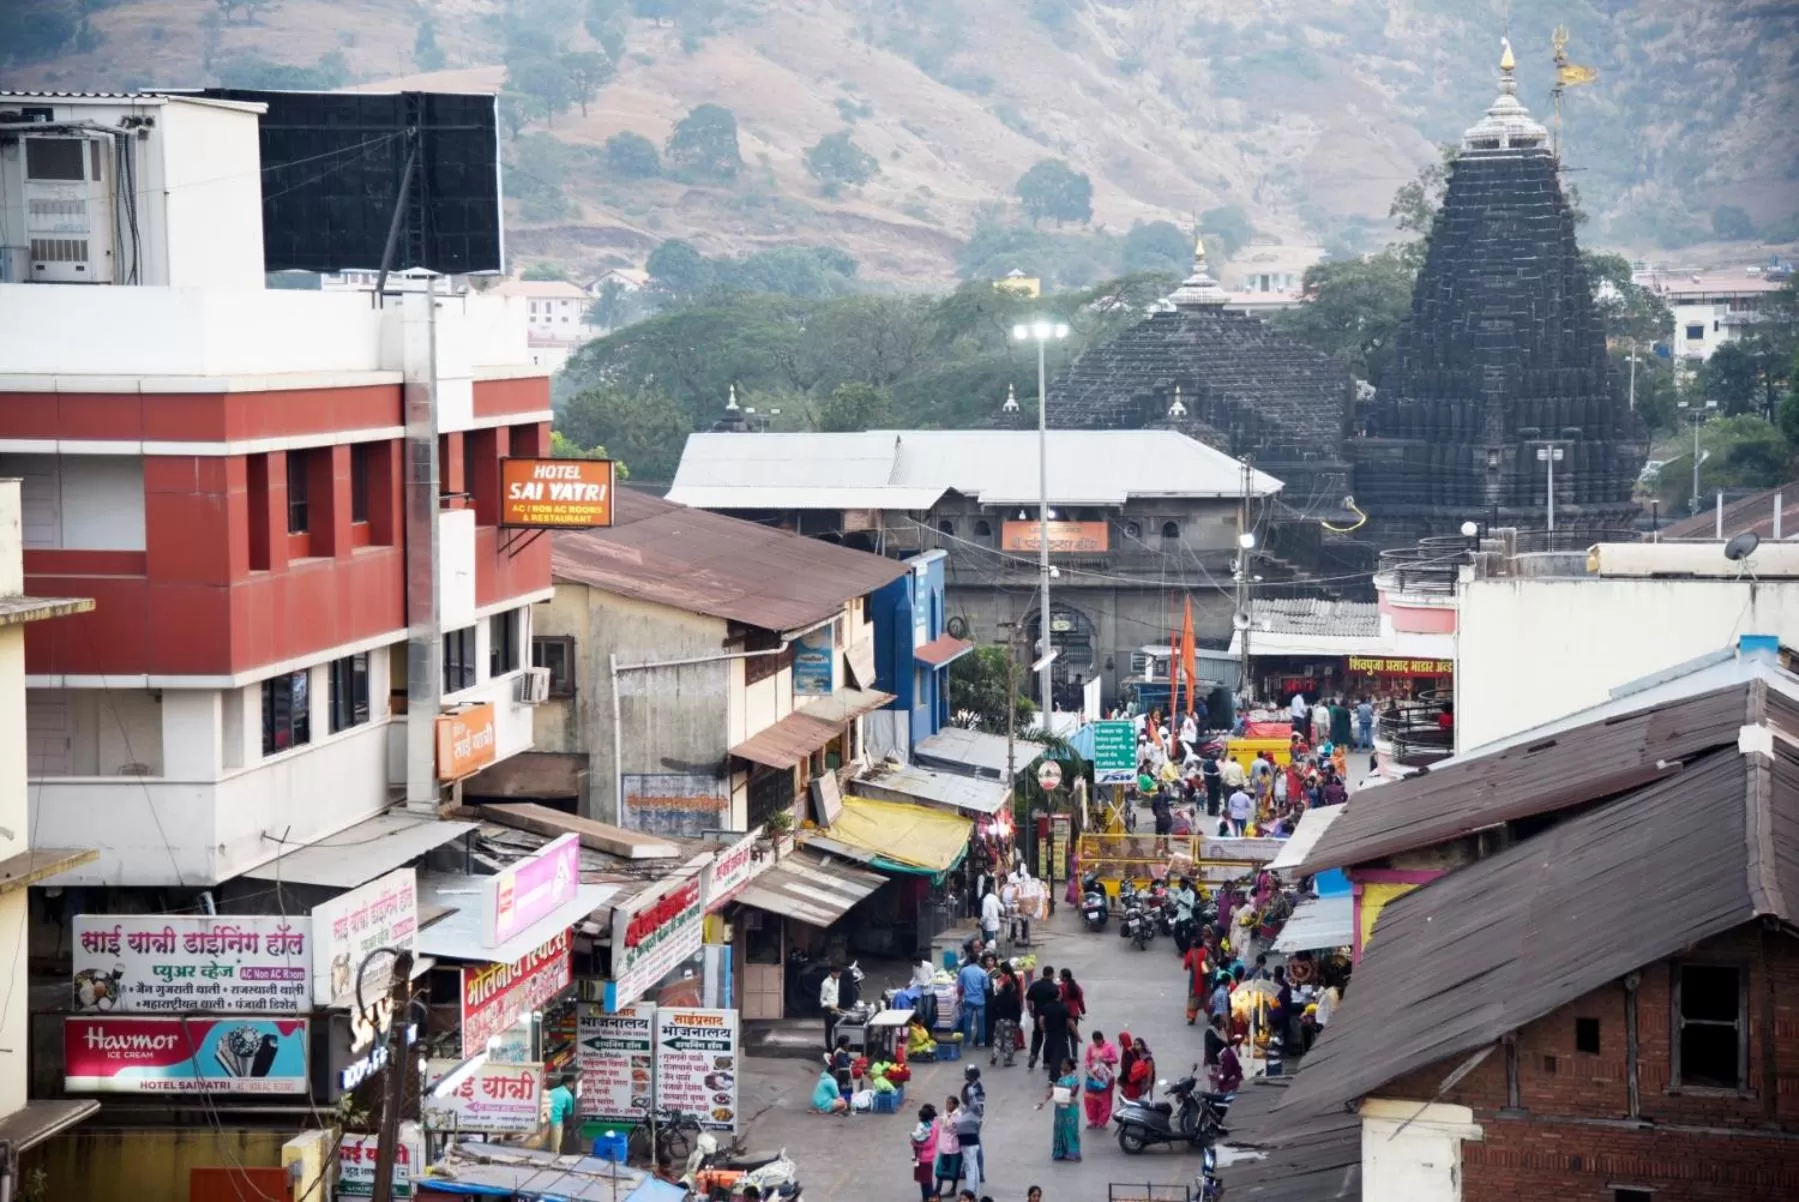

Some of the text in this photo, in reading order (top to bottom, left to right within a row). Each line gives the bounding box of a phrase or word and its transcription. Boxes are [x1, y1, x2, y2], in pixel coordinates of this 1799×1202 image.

[534, 465, 581, 479] HOTEL
[508, 482, 607, 501] SAI YATRI
[554, 505, 567, 513] AC
[531, 514, 592, 522] RESTAURANT
[81, 925, 122, 958] साई
[241, 968, 253, 979] AC
[270, 968, 282, 979] AC
[83, 1026, 178, 1049] Havmor
[662, 1022, 732, 1038] भोजनालय
[140, 1081, 175, 1090] HOTEL
[199, 1081, 230, 1090] YATRI
[482, 1071, 535, 1099] यात्री
